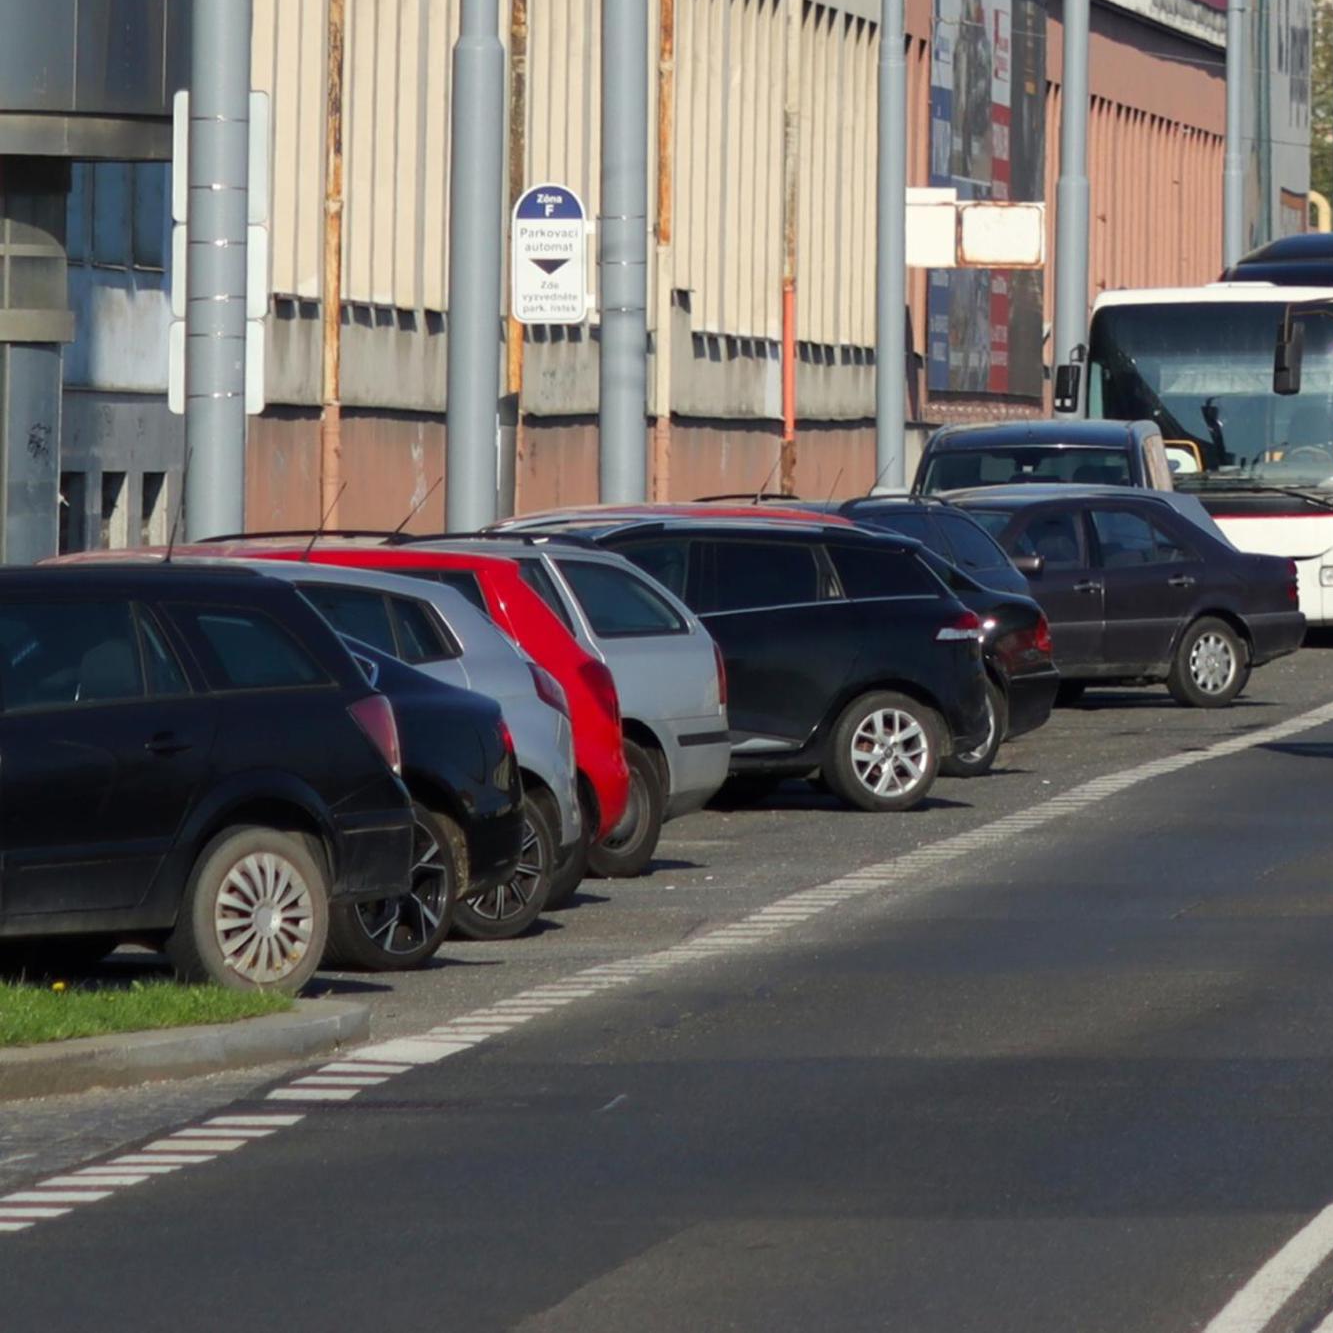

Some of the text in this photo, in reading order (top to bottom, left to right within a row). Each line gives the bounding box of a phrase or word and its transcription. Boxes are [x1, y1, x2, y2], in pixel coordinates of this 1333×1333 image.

[536, 193, 563, 204] Zóna
[544, 205, 554, 217] F
[525, 242, 573, 252] automat
